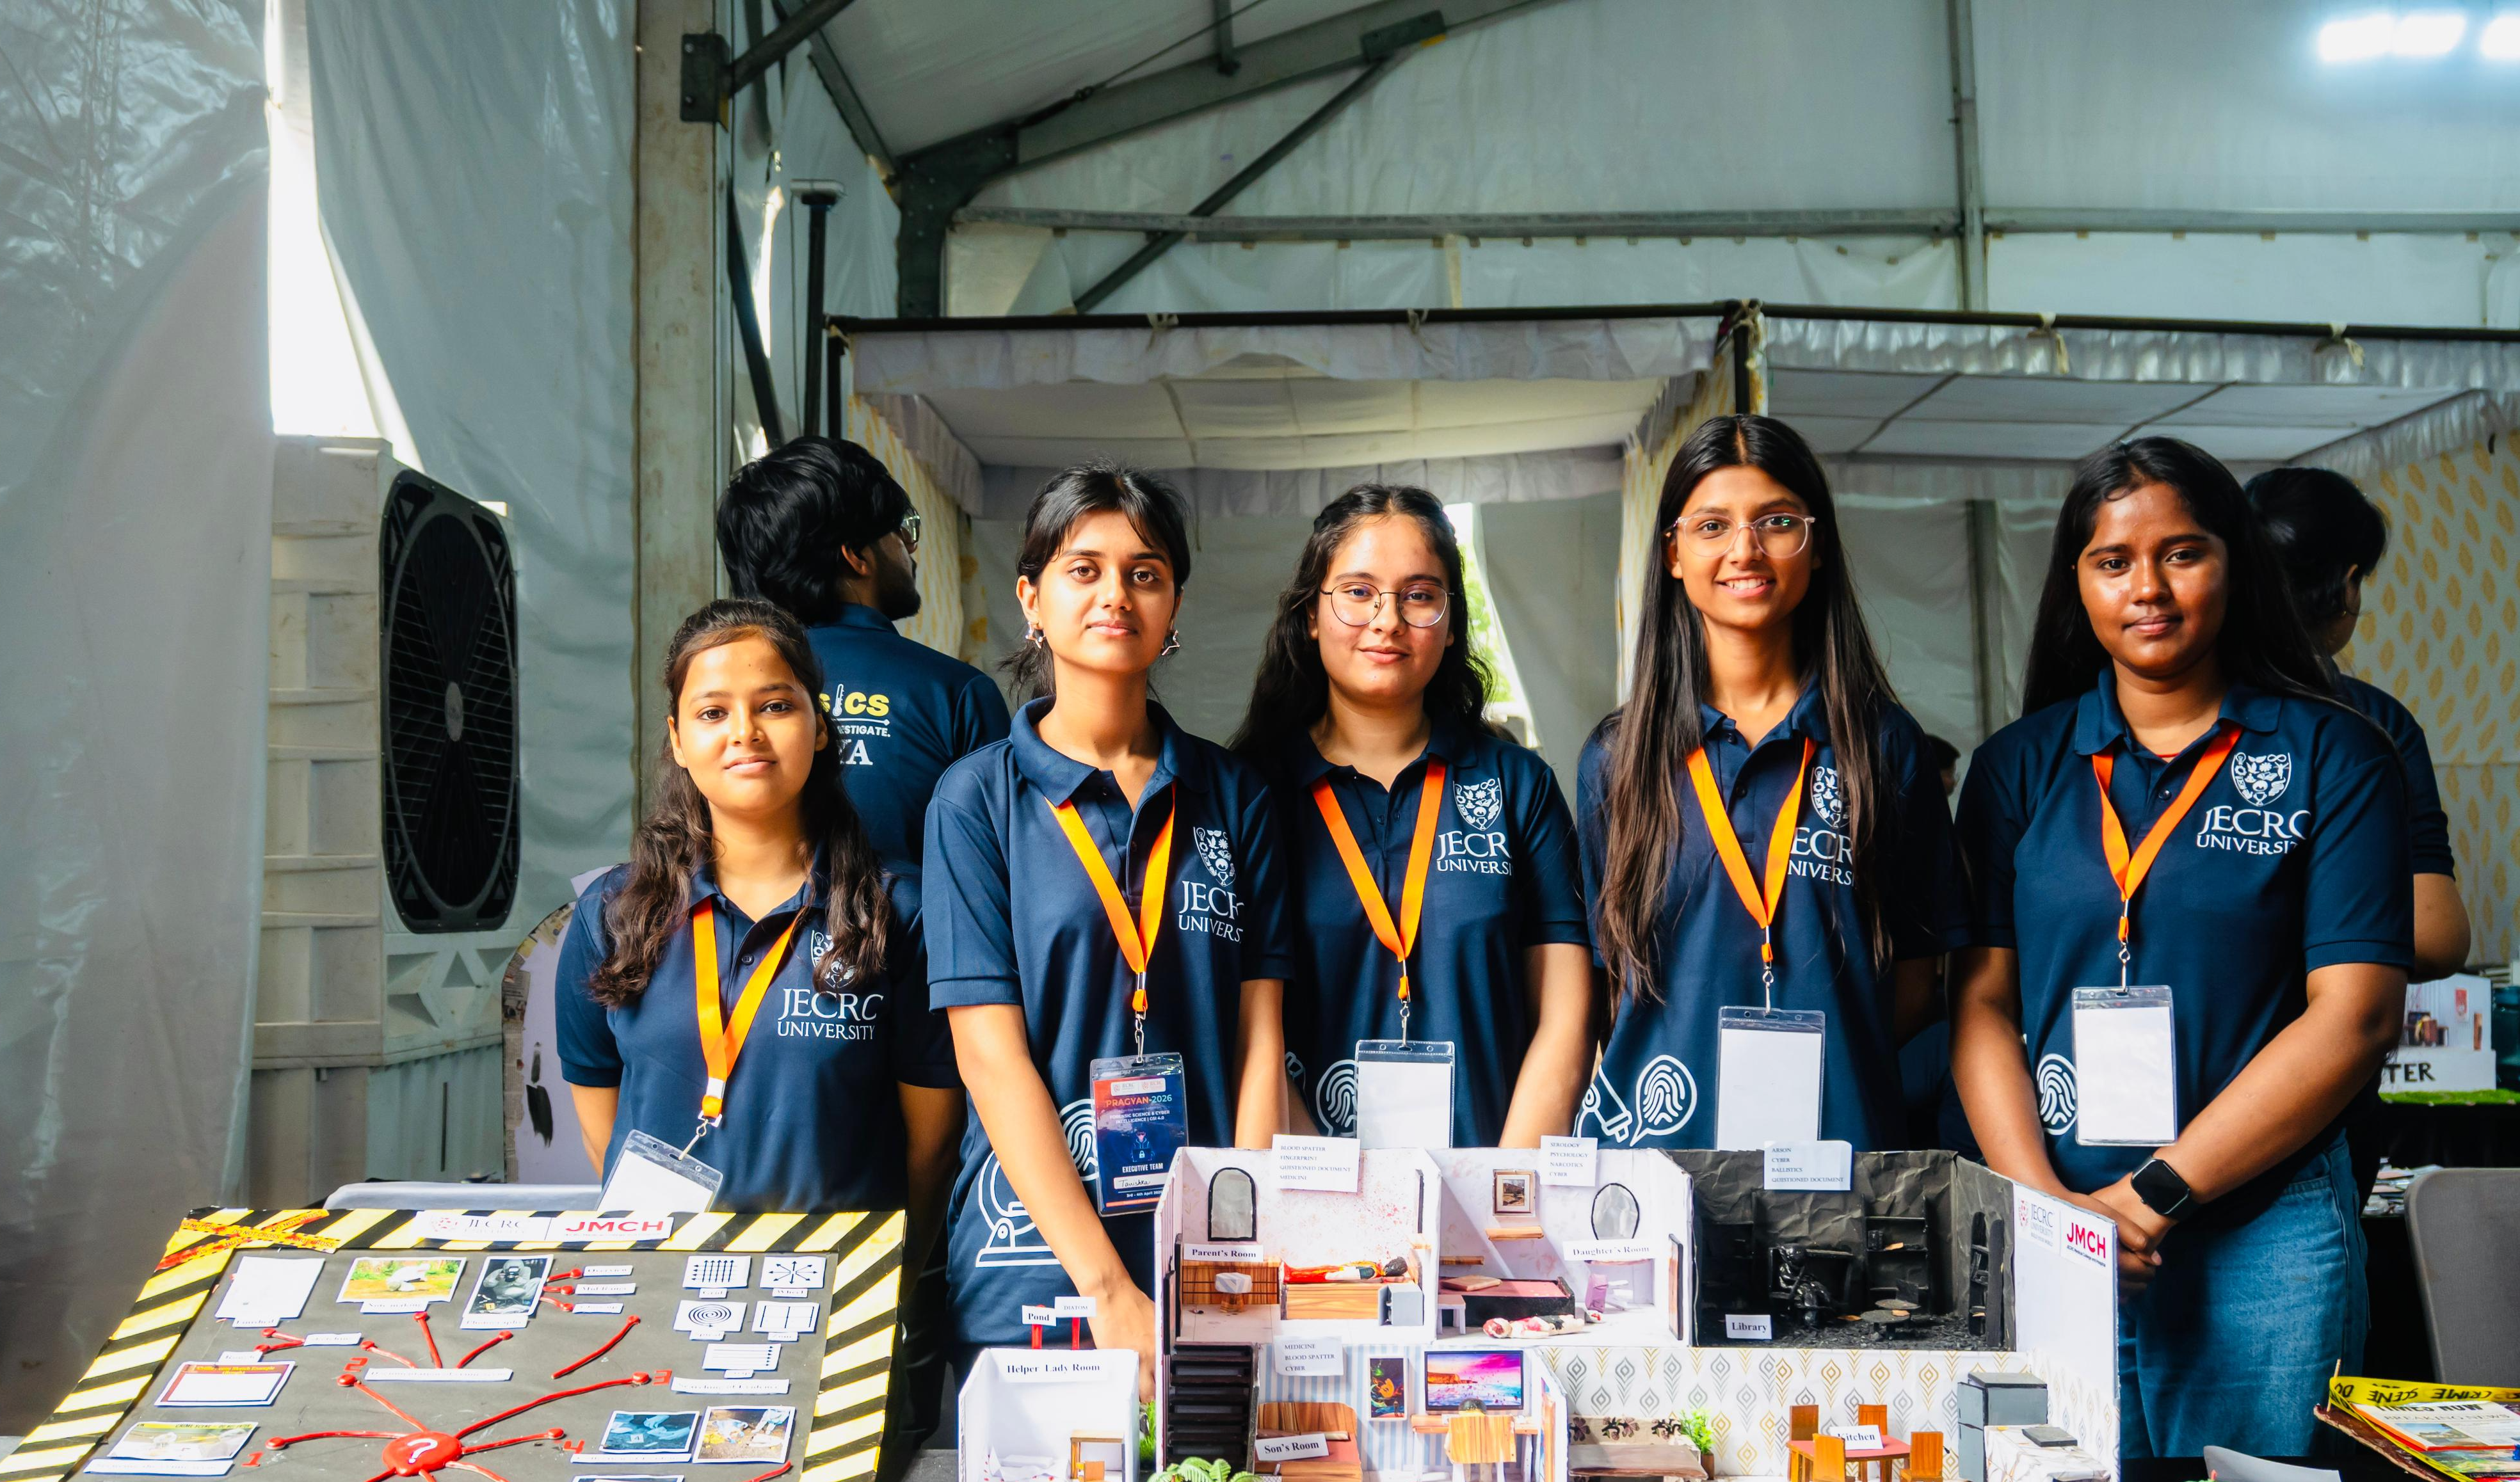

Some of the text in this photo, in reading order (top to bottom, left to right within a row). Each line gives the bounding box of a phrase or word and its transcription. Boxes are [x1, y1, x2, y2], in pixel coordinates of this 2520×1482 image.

[778, 989, 883, 1021] JECRC
[778, 1021, 874, 1040] UNIVERSITY
[1105, 1094, 1173, 1107] PRAGYAN-2026
[1122, 1165, 1148, 1173] EXECUTIVE
[565, 1221, 663, 1232] JMCH
[2031, 1204, 2053, 1228] JECRC
[2067, 1222, 2106, 1259] JMCH
[1192, 1248, 1228, 1257] Parent's
[1573, 1247, 1621, 1255] Daughter's
[1028, 1313, 1050, 1321] Pond
[1732, 1322, 1767, 1334] Library
[344, 1357, 369, 1372] 2
[1007, 1365, 1039, 1374] Helper
[1045, 1364, 1068, 1374] Lady
[2431, 1389, 2492, 1400] CRIME
[1264, 1442, 1319, 1454] Son's Room
[241, 1451, 264, 1467] 1
